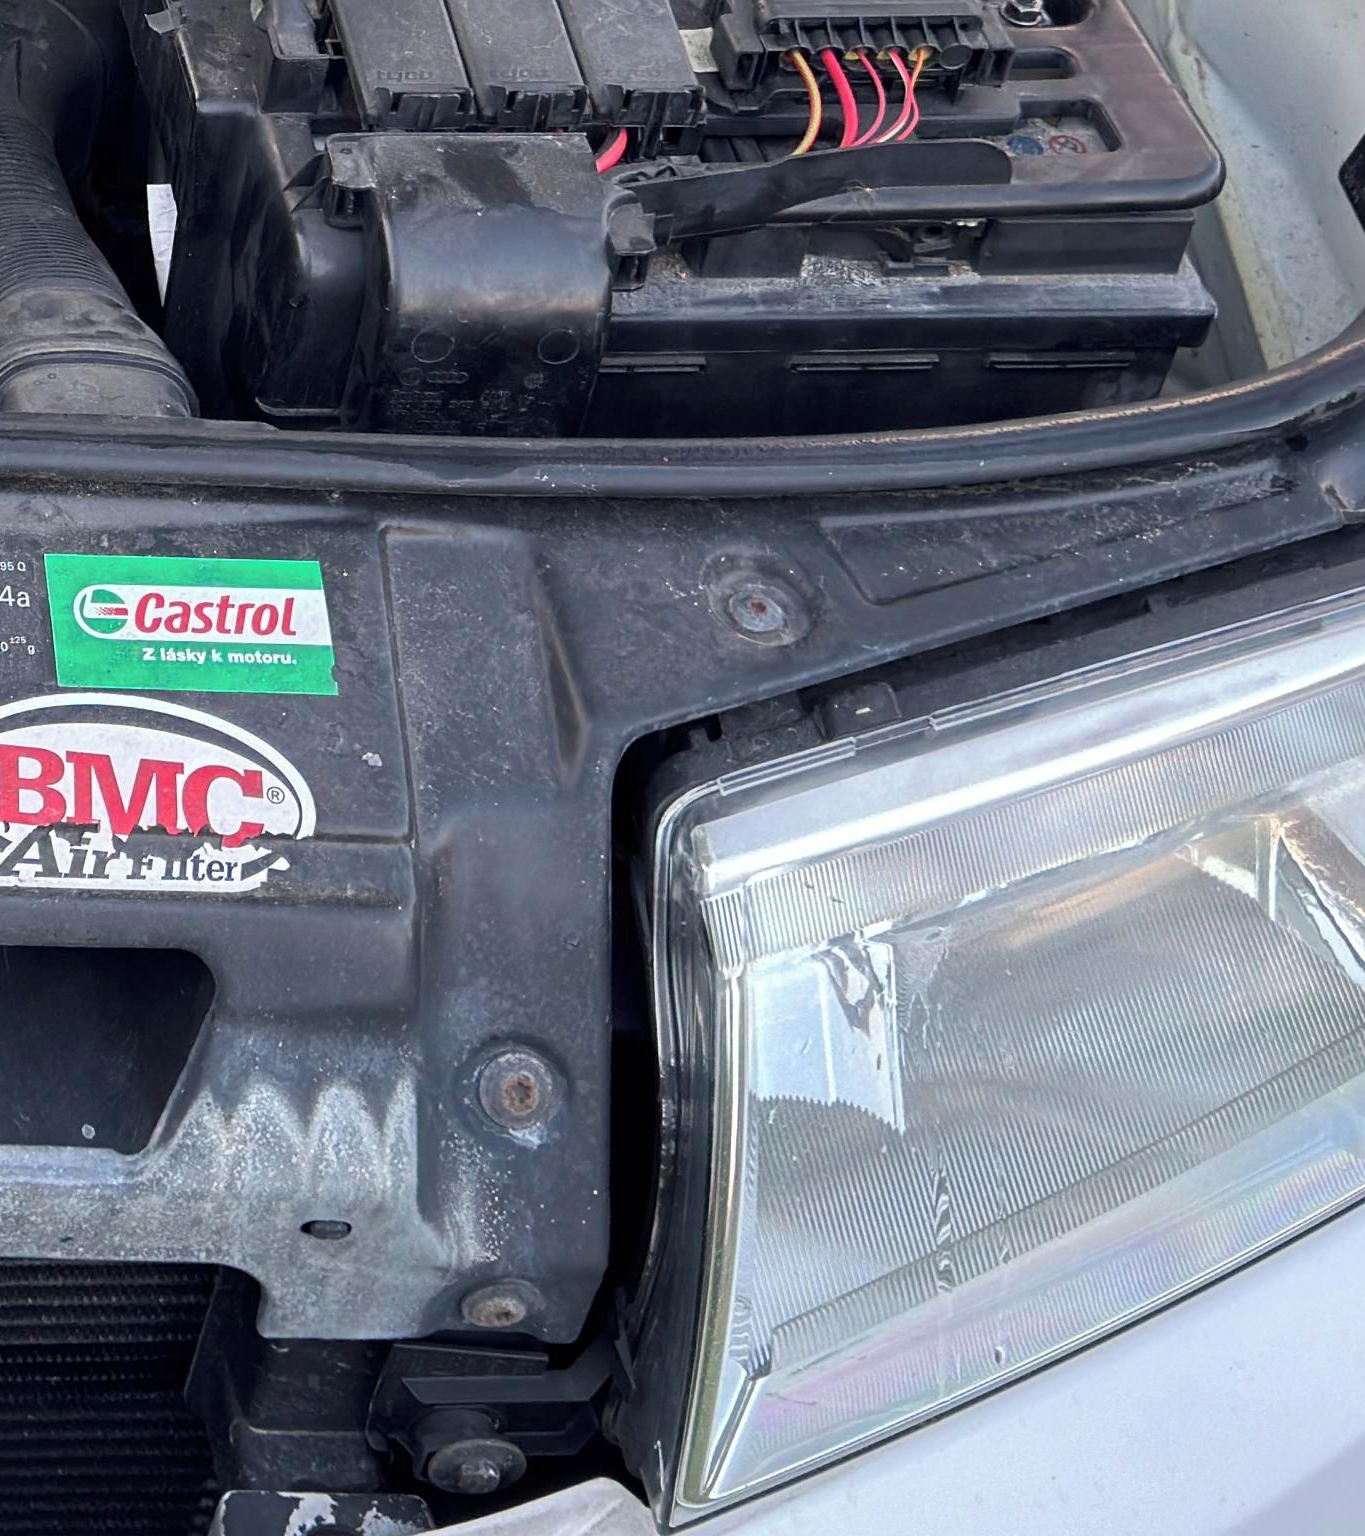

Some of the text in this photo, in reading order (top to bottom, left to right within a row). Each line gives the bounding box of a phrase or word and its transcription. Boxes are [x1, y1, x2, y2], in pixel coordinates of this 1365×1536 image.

[17, 561, 27, 572] Q
[134, 592, 297, 636] Castrol
[10, 636, 27, 645] ±25
[27, 644, 36, 655] g
[142, 646, 298, 665] Z lásky k motoru.
